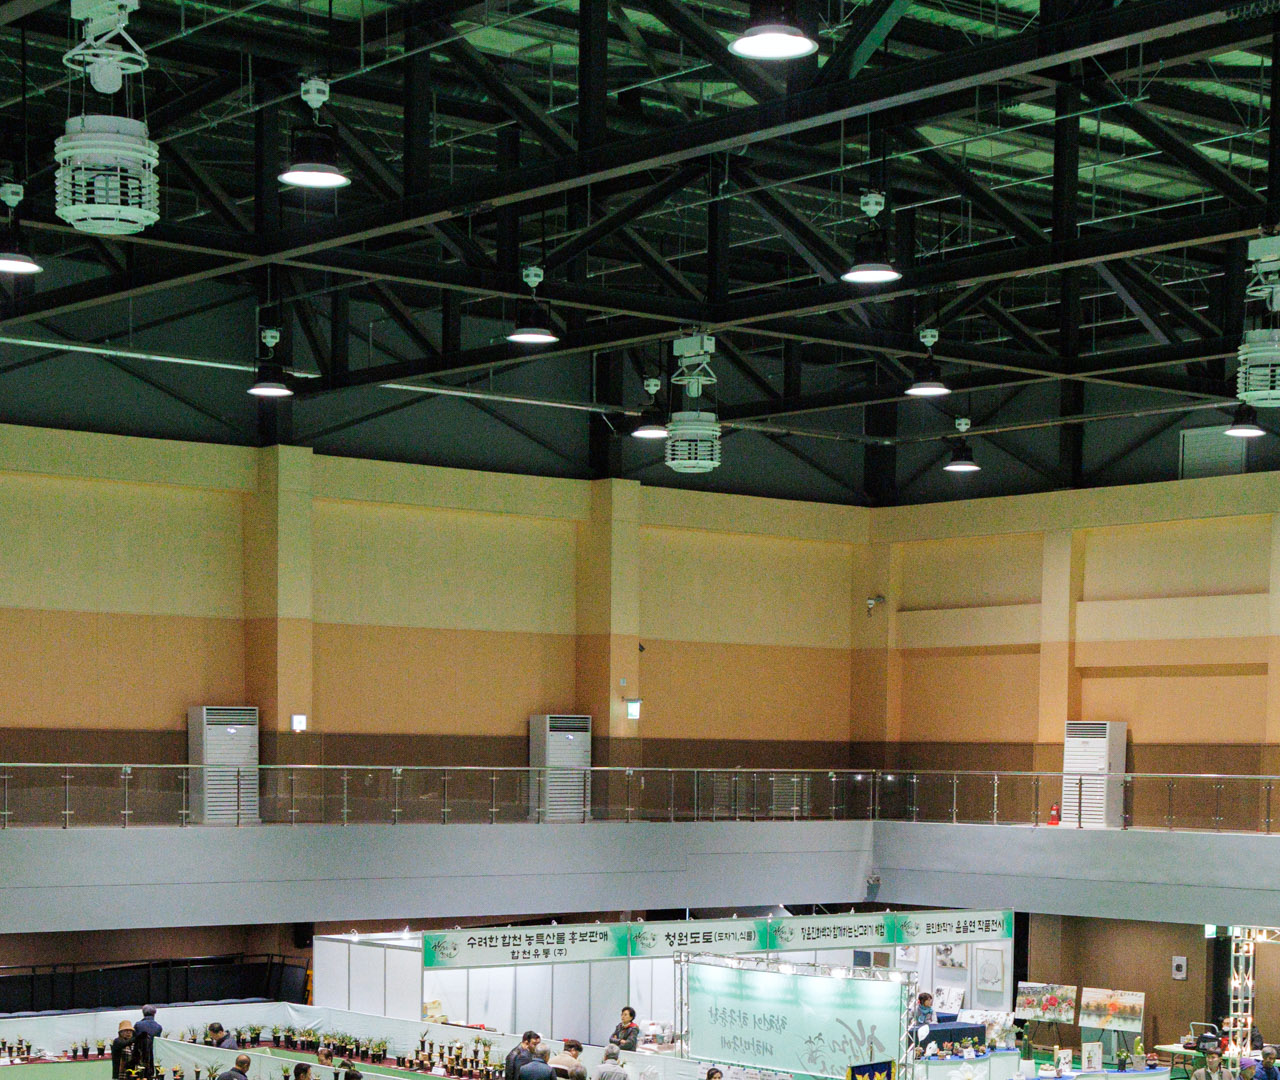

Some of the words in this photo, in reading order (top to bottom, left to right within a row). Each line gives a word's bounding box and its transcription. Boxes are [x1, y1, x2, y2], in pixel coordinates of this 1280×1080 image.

[977, 919, 1005, 933] 작품전시
[467, 935, 498, 949] 수려한
[501, 934, 522, 947] 합천
[525, 932, 567, 946] 농특산물
[569, 931, 608, 945] 홍보판매
[510, 948, 551, 960] 합천유통
